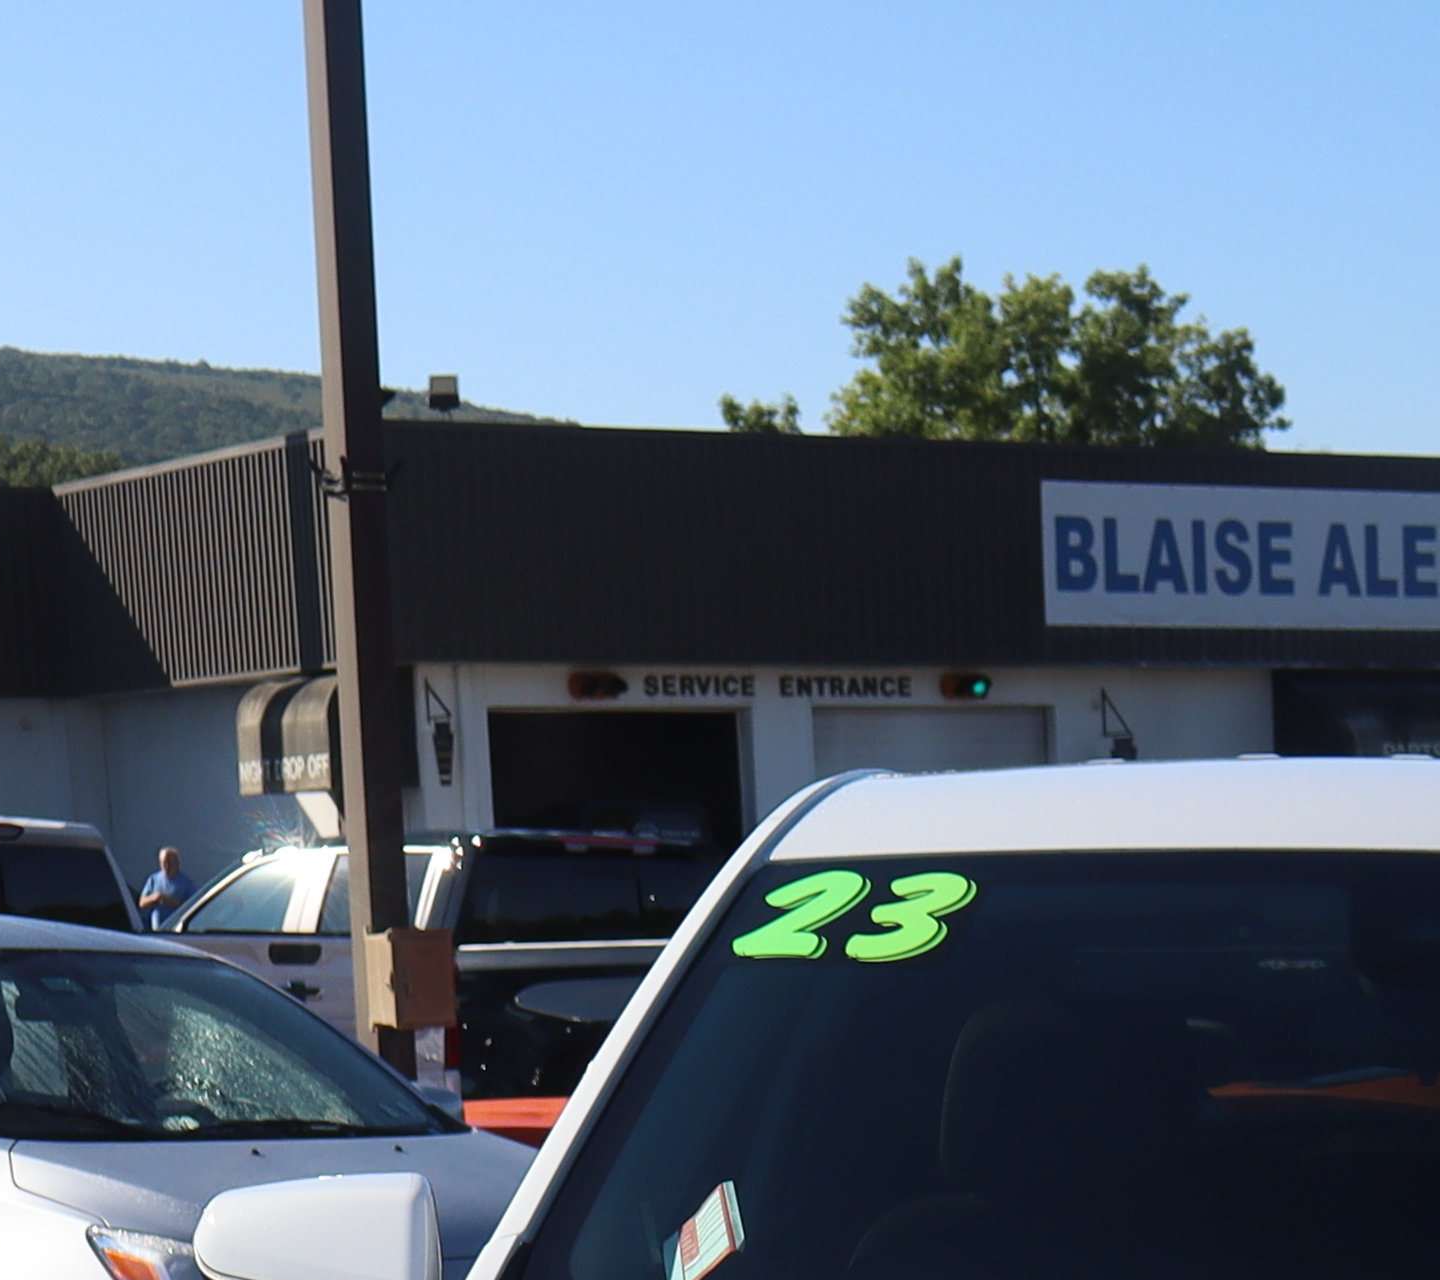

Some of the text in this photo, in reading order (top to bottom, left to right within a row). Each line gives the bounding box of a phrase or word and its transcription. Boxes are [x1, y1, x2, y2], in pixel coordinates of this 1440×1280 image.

[1055, 515, 1296, 597] BLAISE
[643, 674, 912, 698] SERVICE ENTRANCE
[274, 755, 304, 780] DROP
[307, 752, 330, 779] OFF
[731, 869, 978, 963] 23
